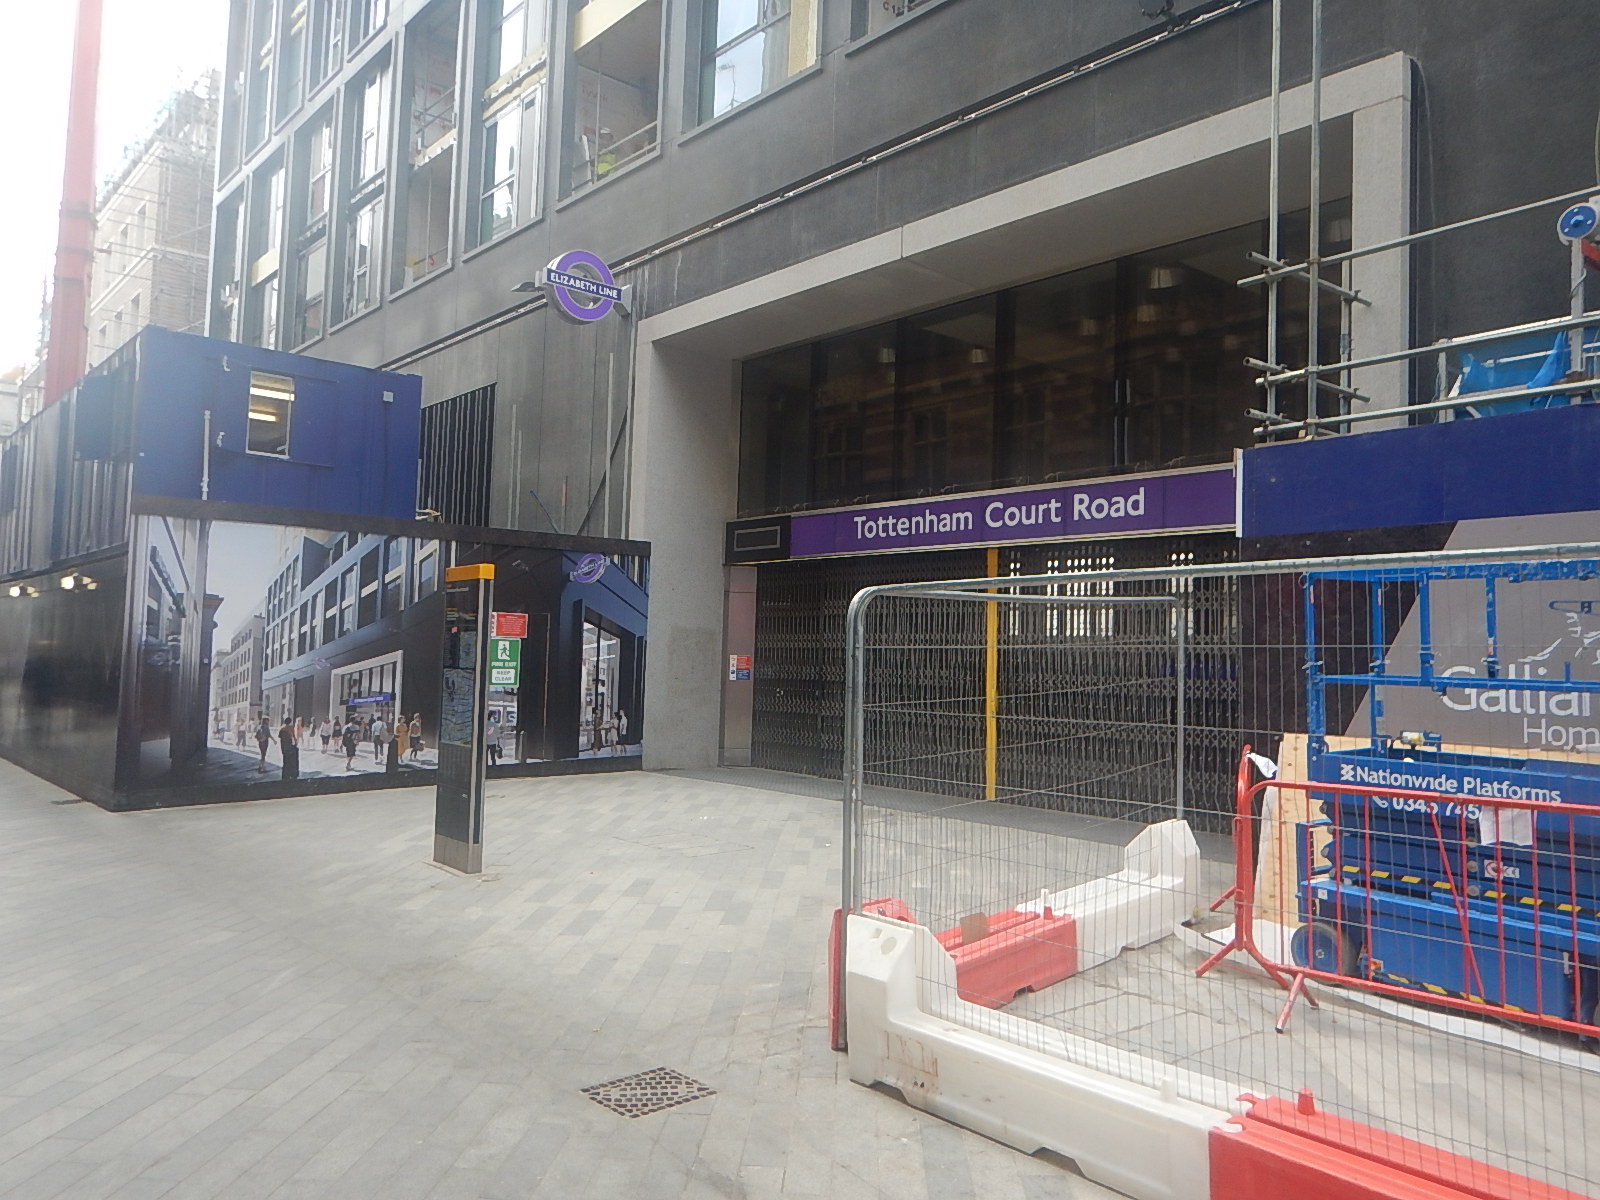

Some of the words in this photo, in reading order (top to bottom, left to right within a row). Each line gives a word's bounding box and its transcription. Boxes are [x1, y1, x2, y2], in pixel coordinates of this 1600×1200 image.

[550, 272, 597, 292] ELIZABETH
[598, 285, 618, 299] LINE
[853, 509, 973, 540] Tottenham
[984, 498, 1062, 529] Court
[1072, 487, 1145, 521] Road
[1355, 766, 1458, 793] Nationwide
[1463, 777, 1562, 804] Platforms
